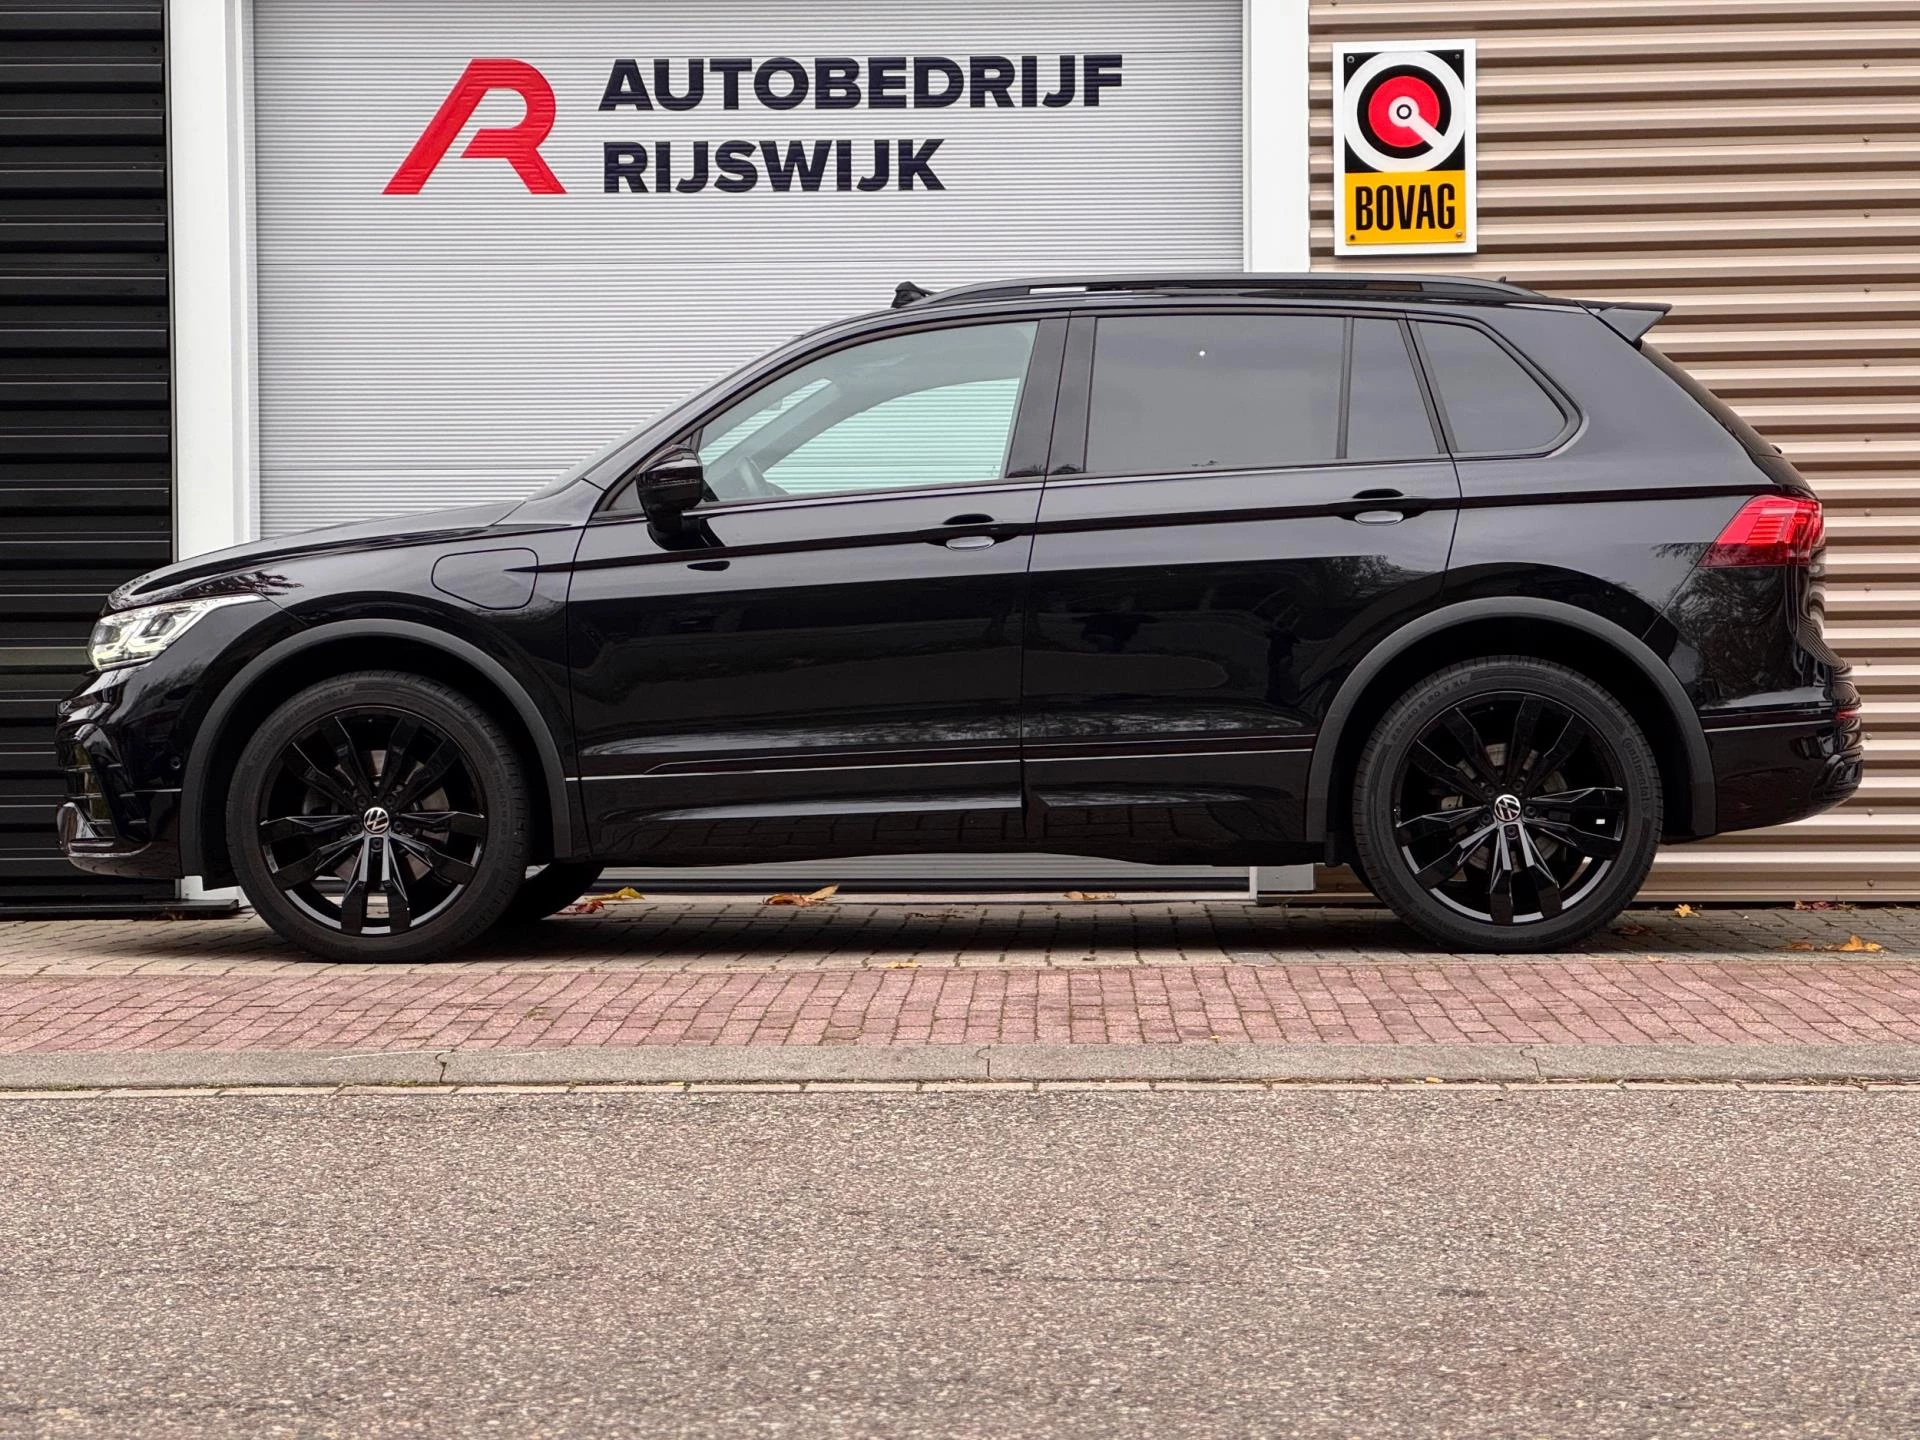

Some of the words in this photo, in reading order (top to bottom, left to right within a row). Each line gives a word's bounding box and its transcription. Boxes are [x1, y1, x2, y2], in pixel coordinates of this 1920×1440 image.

[599, 53, 1122, 112] AUTOBEDRIJF
[603, 138, 947, 194] RIJSWIJK
[1355, 183, 1456, 231] BOVAG
